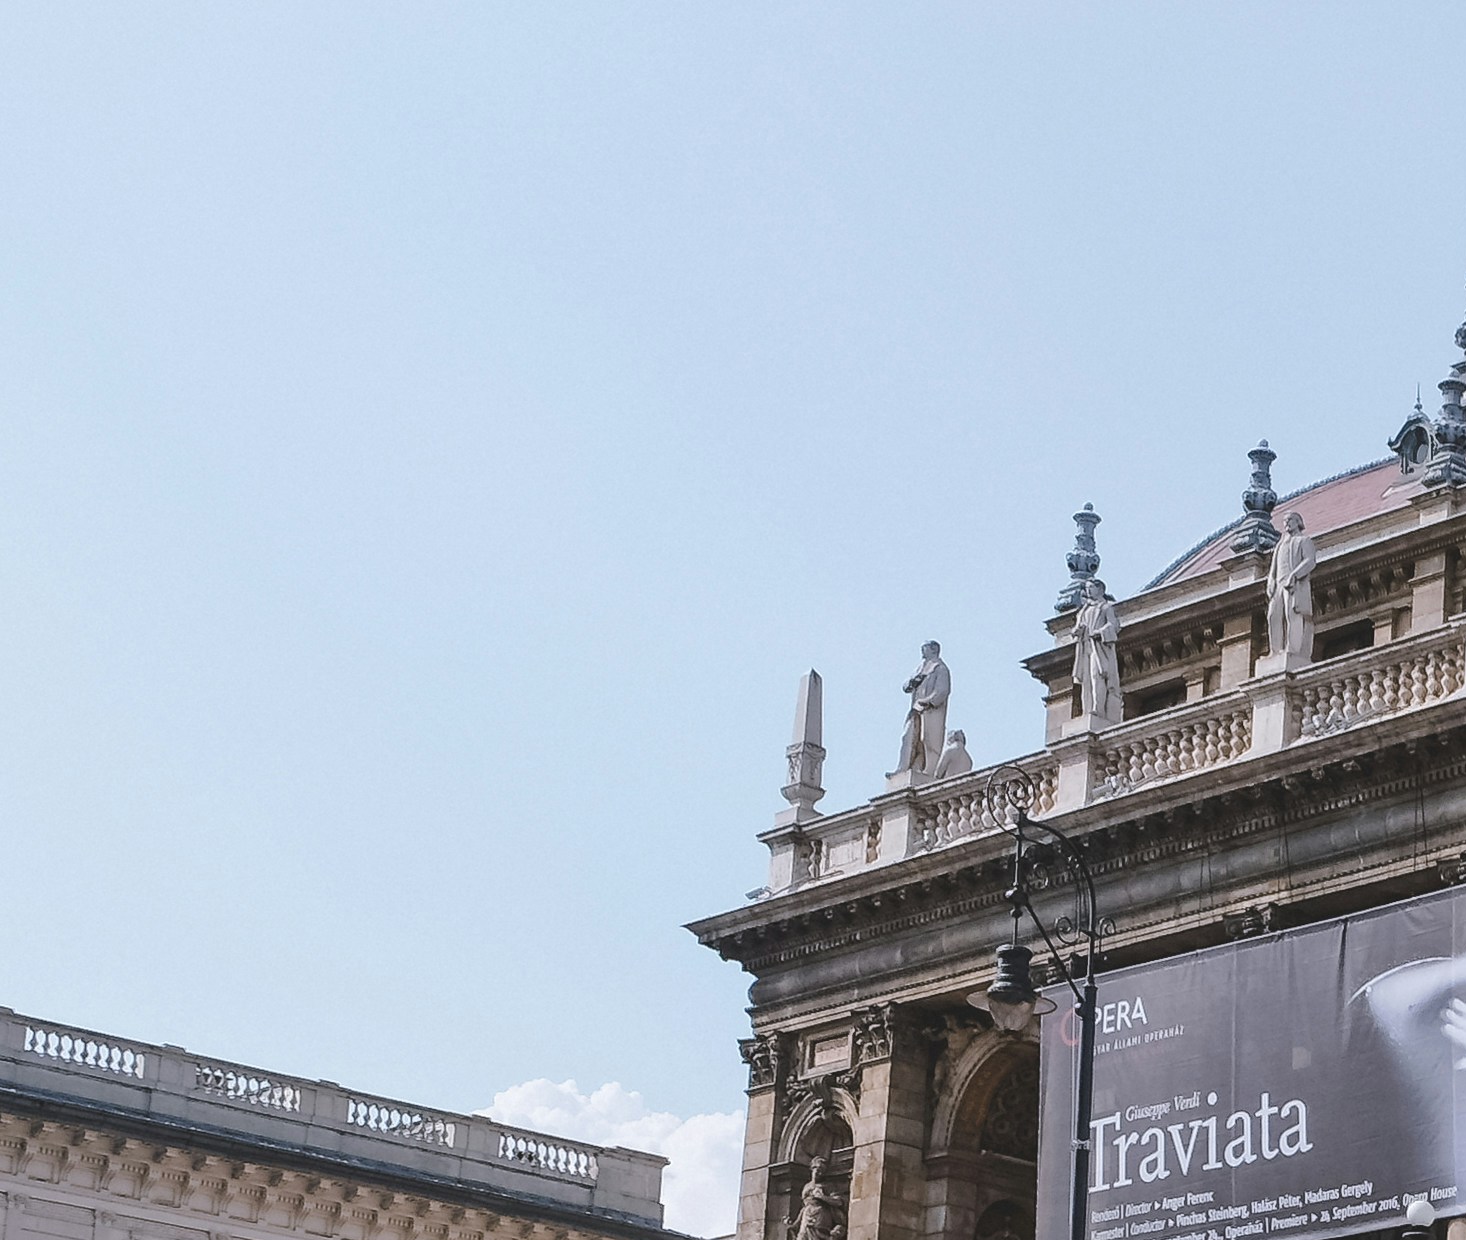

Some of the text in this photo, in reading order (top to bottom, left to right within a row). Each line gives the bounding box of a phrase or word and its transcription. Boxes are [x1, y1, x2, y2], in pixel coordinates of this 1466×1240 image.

[1125, 1091, 1201, 1121] Giuseppe Verdi
[1089, 1092, 1314, 1193] Traviata
[1130, 1219, 1167, 1235] Conductor
[1176, 1211, 1206, 1226] Pinchas
[1251, 1199, 1277, 1213] Halász
[1305, 1188, 1339, 1204] Madaras
[1341, 1181, 1373, 1198] Gergely
[1162, 1197, 1185, 1211] Anger
[1187, 1191, 1215, 1205] Ferenc
[1225, 1220, 1264, 1240] Operaház
[1271, 1214, 1308, 1230] Premiere
[1332, 1201, 1377, 1221] September
[1430, 1185, 1458, 1201] House
